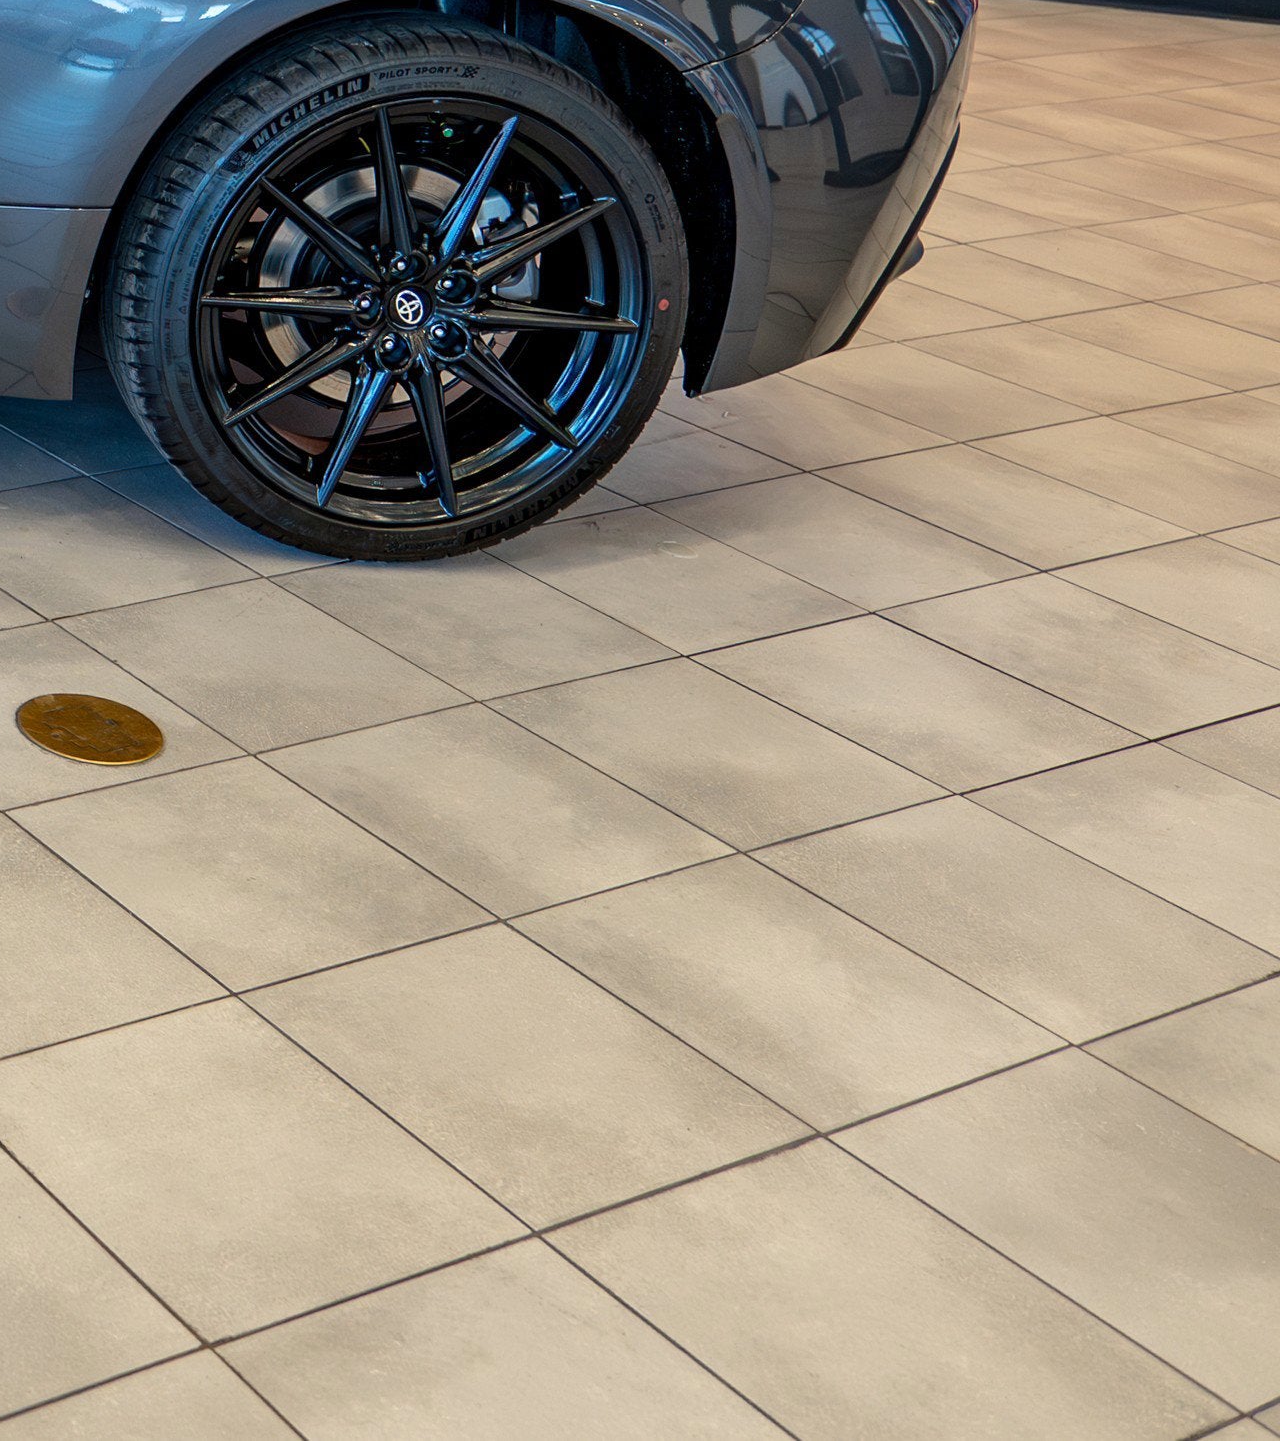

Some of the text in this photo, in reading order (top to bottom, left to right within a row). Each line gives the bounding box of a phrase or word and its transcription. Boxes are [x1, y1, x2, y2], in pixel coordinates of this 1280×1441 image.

[378, 68, 411, 81] PILOT
[413, 66, 453, 76] SPORT
[251, 77, 364, 151] MICHELIN
